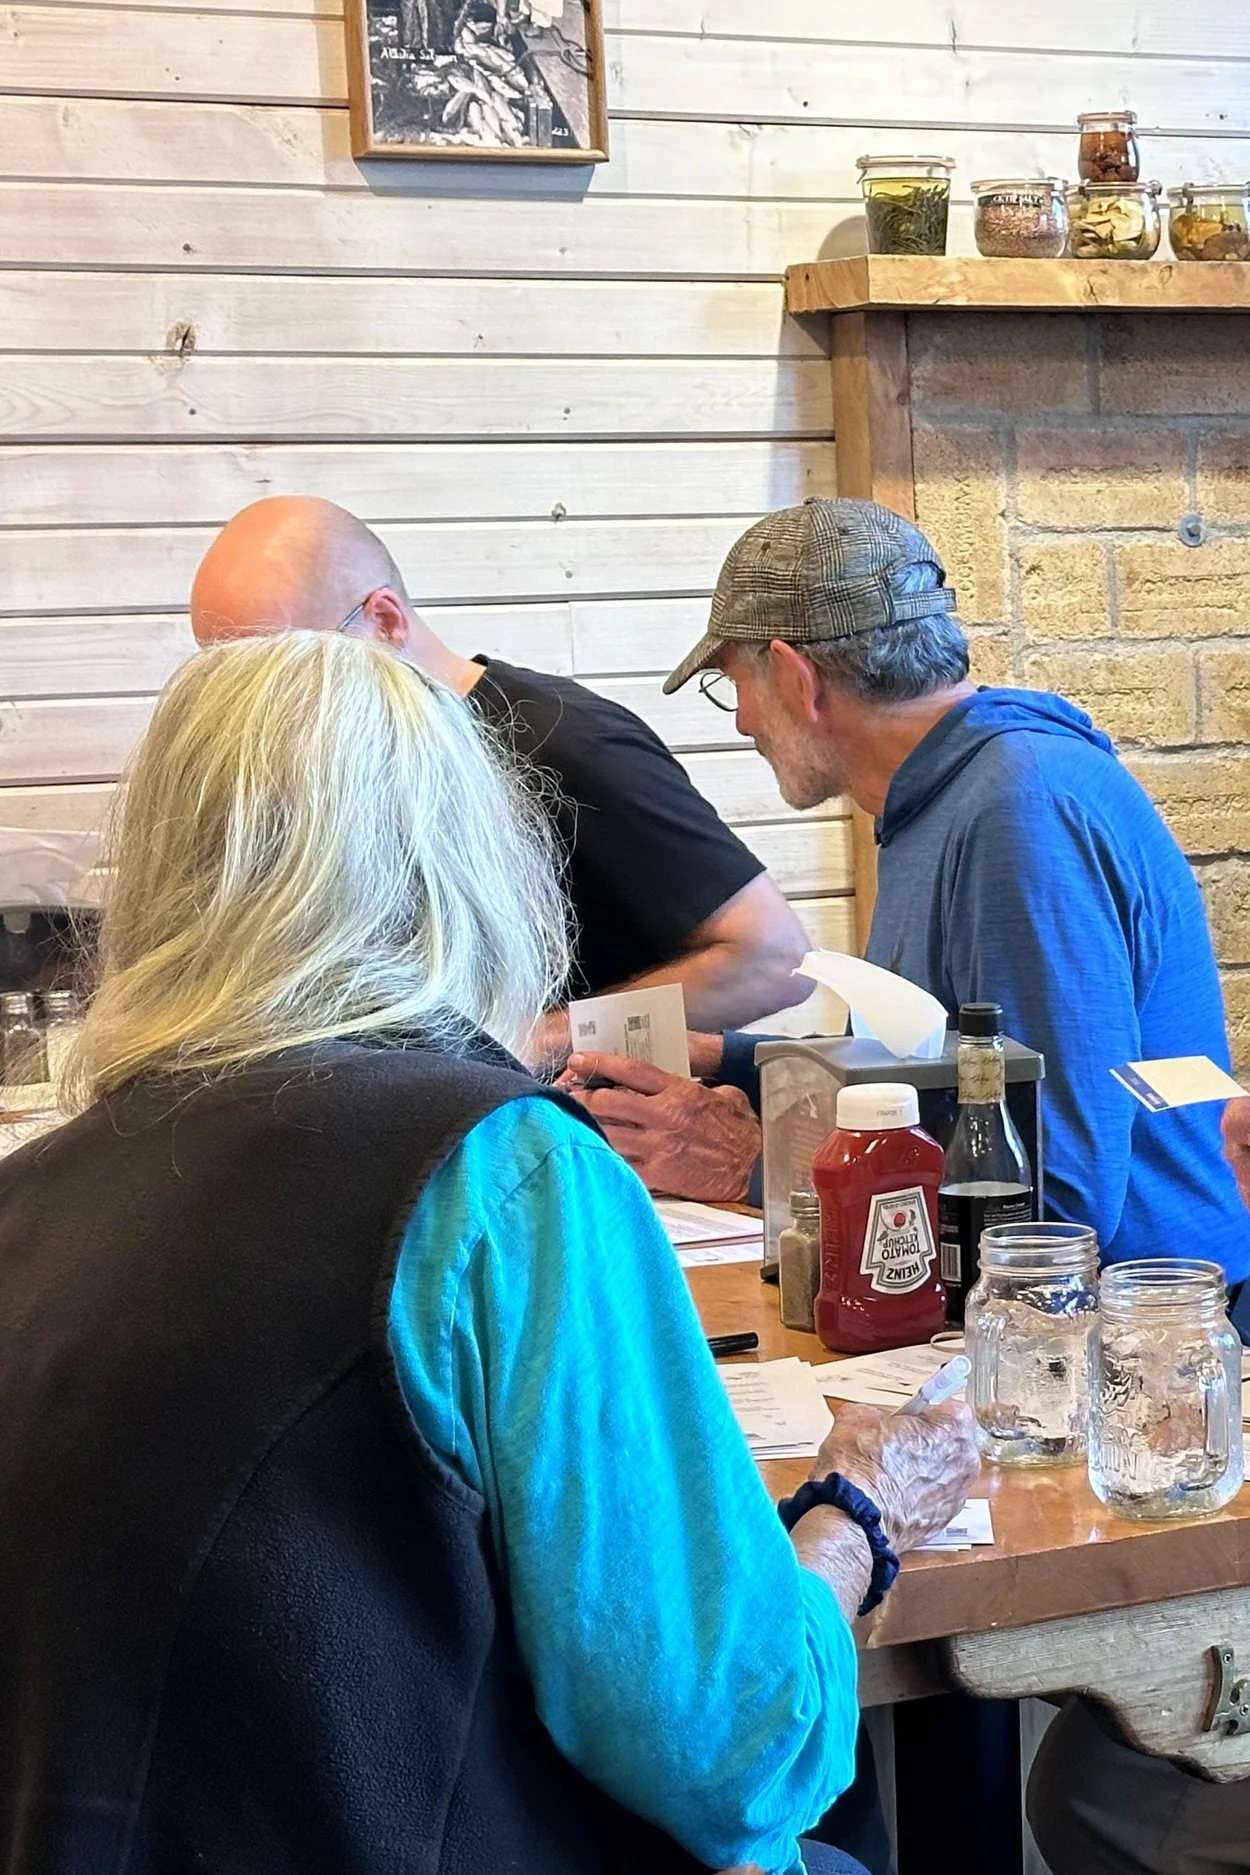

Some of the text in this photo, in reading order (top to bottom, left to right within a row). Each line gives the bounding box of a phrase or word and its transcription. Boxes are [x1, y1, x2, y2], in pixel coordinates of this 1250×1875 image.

[882, 1233, 919, 1249] KETCHUP
[881, 1241, 921, 1261] TOMATO
[886, 1262, 920, 1281] HEINZ
